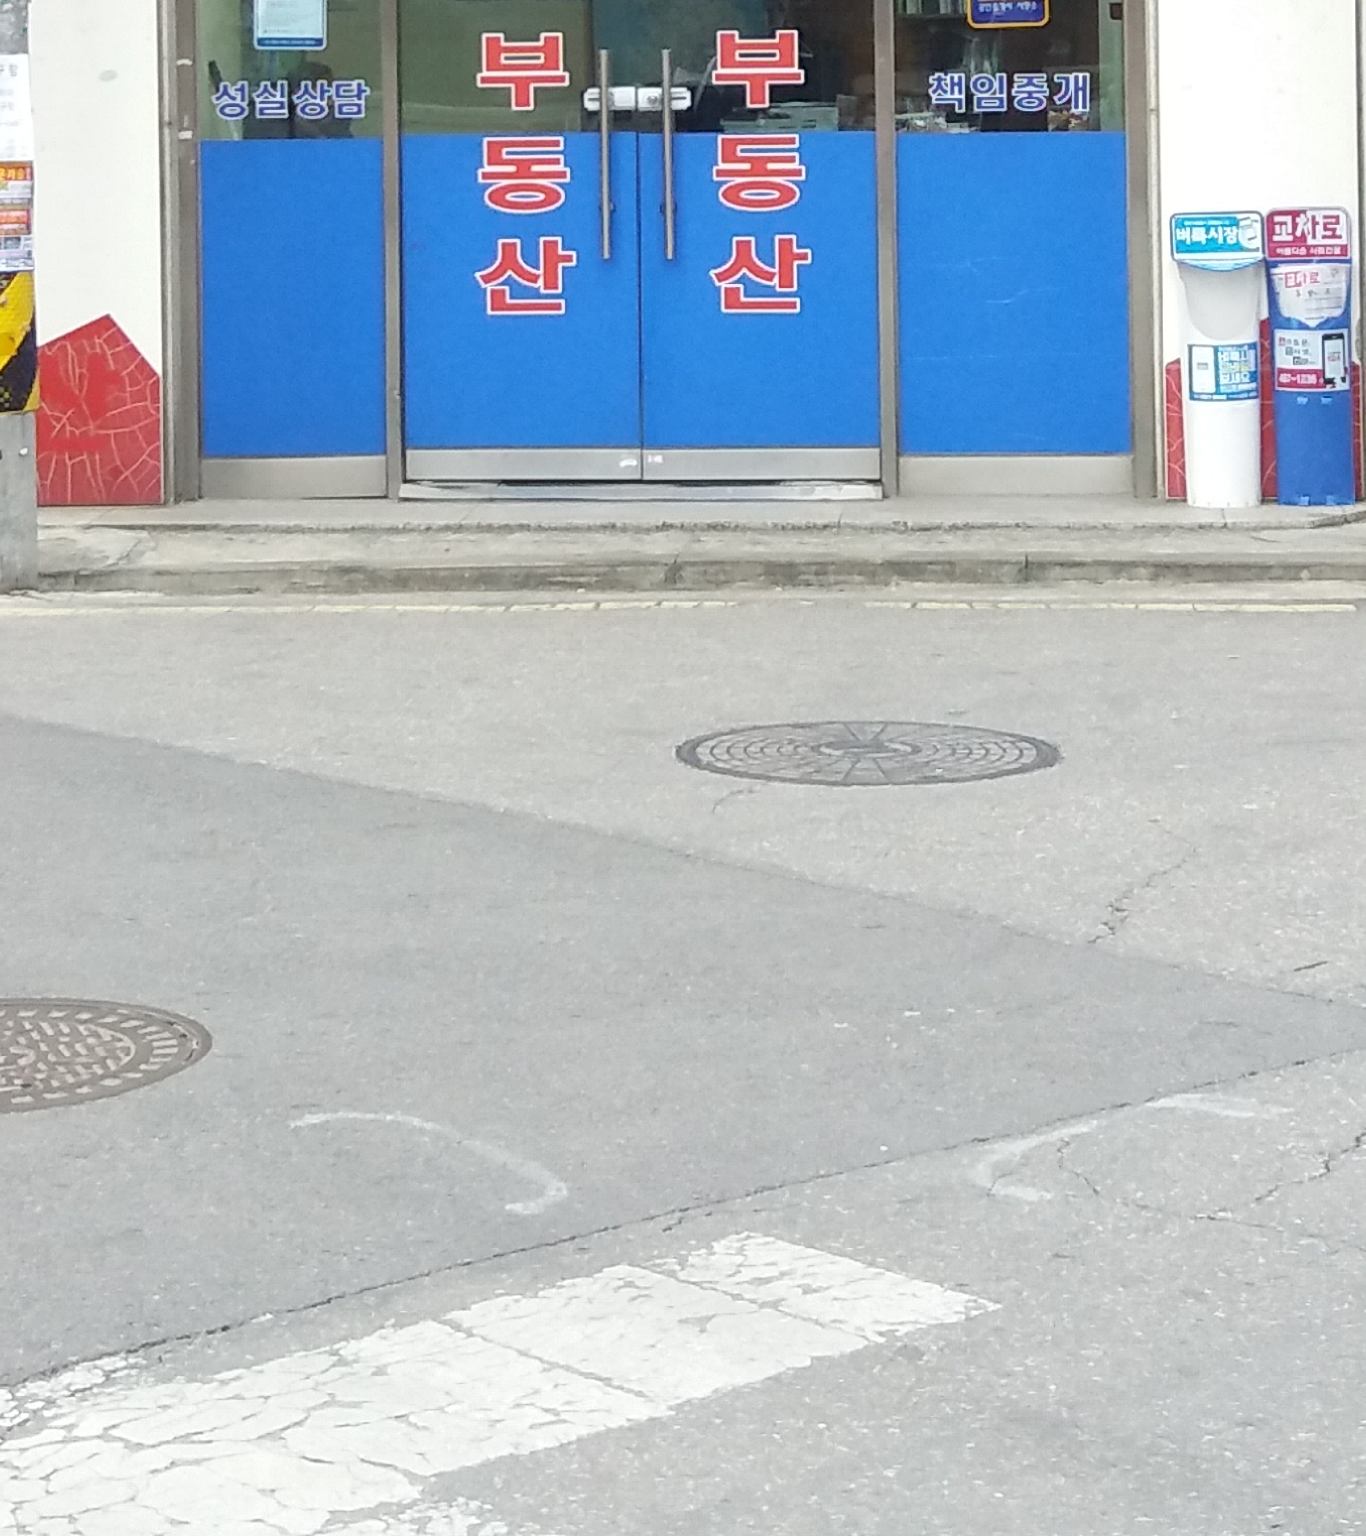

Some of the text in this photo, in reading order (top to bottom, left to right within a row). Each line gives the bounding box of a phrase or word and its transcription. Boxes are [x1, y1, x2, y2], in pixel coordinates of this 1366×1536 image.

[212, 79, 370, 121] 성실상담
[929, 72, 1091, 113] 책임중개
[475, 32, 577, 316] 부동산
[709, 29, 812, 313] 부동산
[1272, 214, 1343, 243] 교차로
